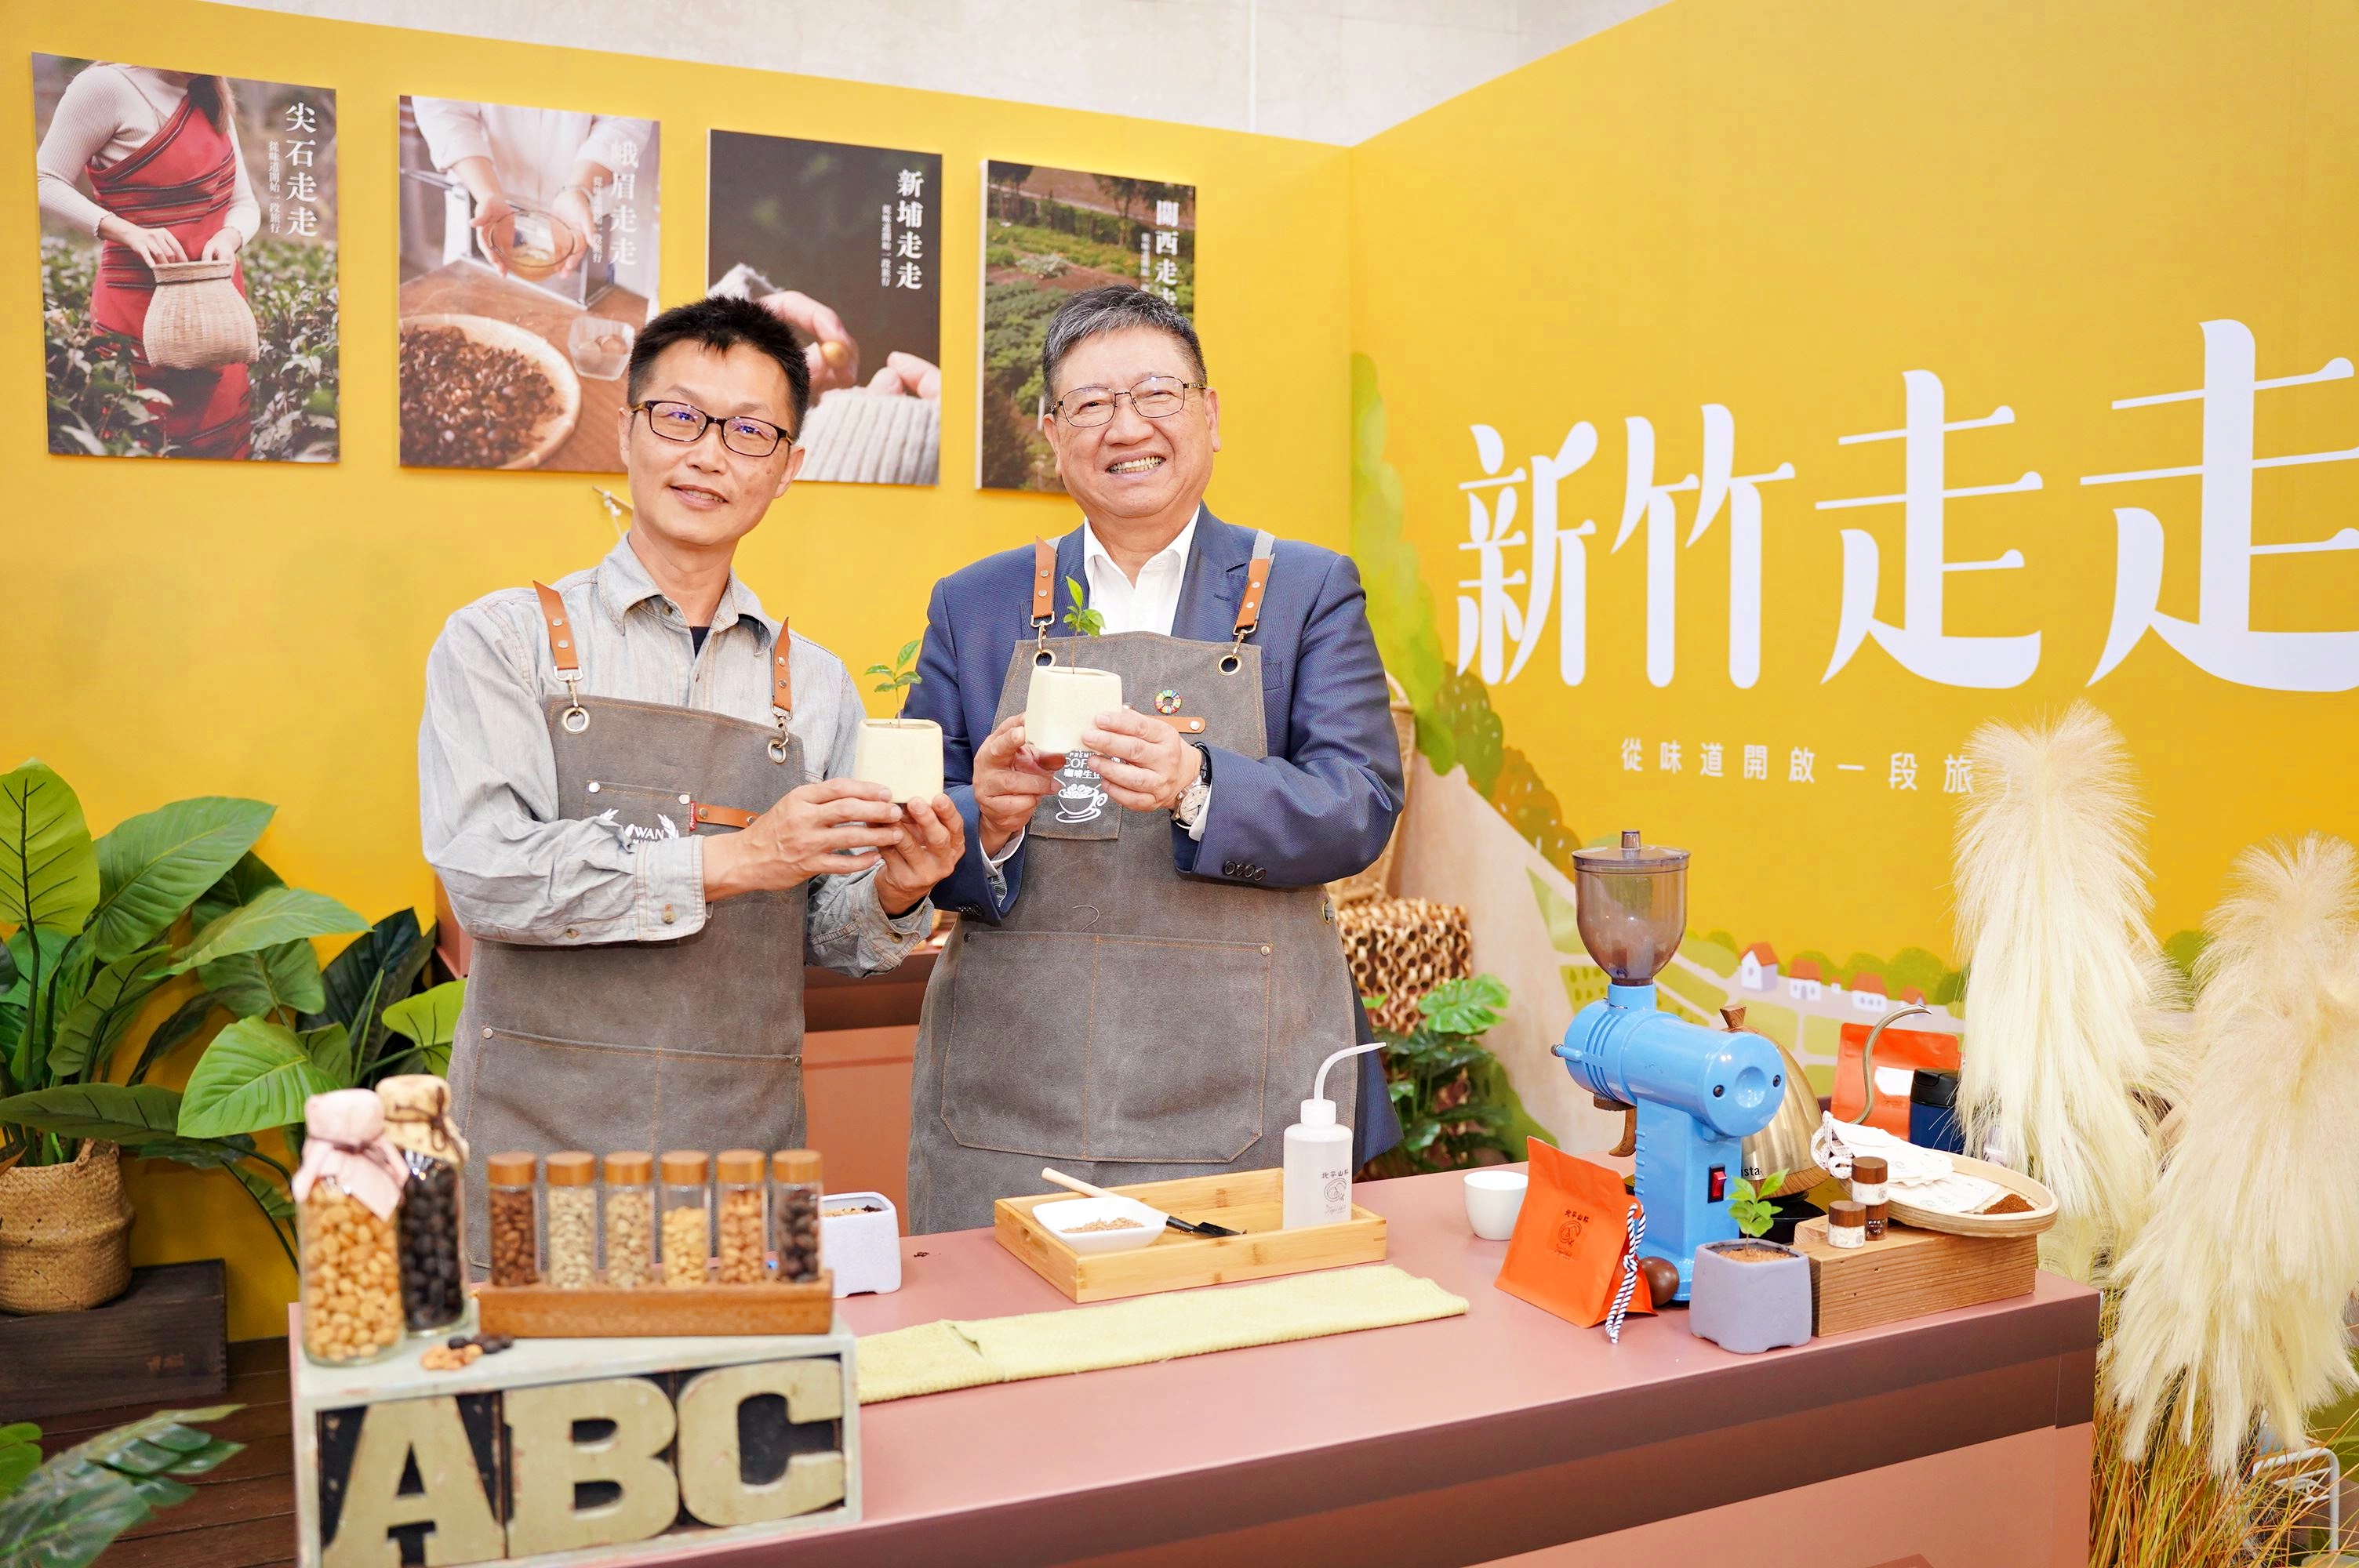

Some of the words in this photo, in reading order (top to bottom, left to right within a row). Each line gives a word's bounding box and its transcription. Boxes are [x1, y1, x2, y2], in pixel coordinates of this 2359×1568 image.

[285, 102, 318, 237] 尖石走走
[609, 140, 638, 265] 峨眉走走
[896, 169, 925, 290] 新埔走走
[1456, 318, 2359, 693] 新竹走走
[1621, 737, 1976, 794] 從味道開啟一段旅
[1740, 1166, 1760, 1177] ista
[321, 1358, 845, 1568] ABC
